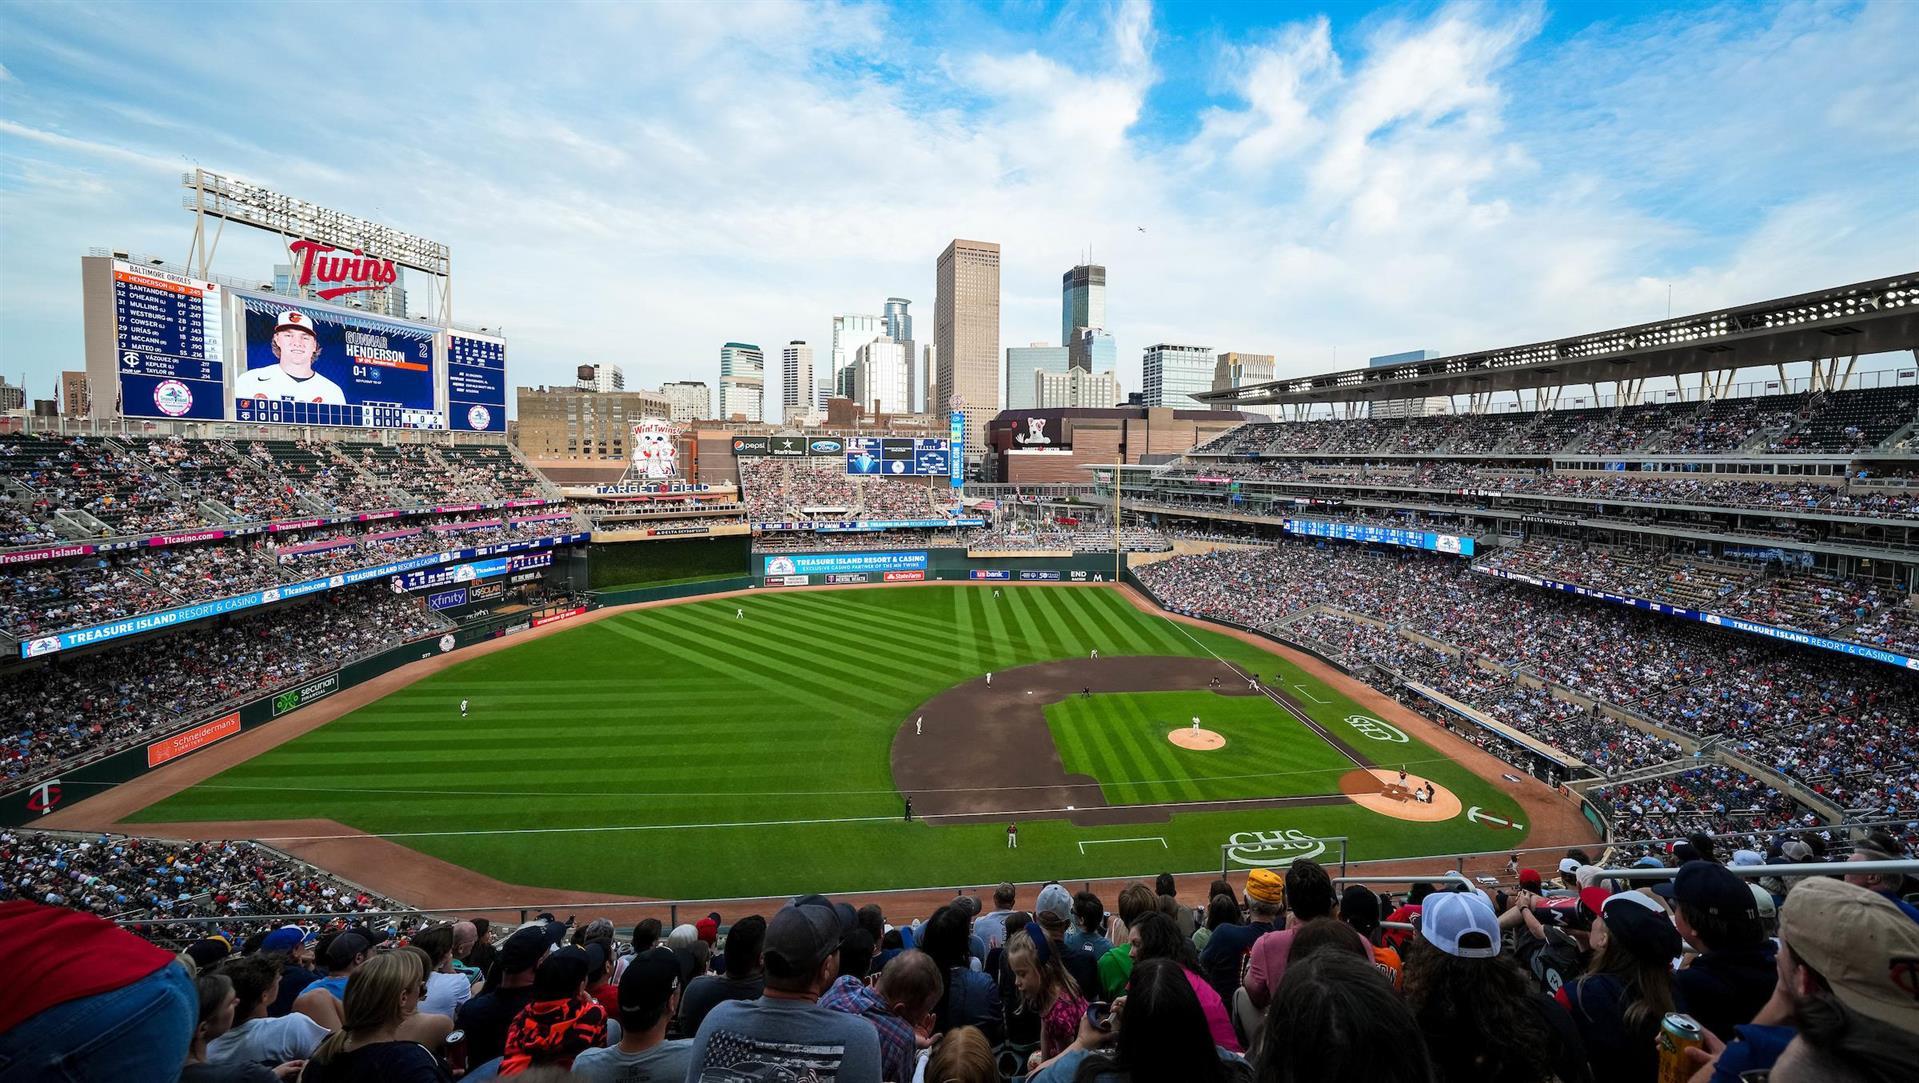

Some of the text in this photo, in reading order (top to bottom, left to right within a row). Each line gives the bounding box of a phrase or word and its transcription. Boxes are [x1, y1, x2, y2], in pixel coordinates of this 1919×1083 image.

[289, 240, 396, 287] Twins
[130, 265, 191, 284] BALTIMORE ORIOLES
[128, 276, 167, 288] HENDERSON
[129, 284, 168, 297] SANTANDER
[129, 293, 159, 303] O'HEARN
[130, 301, 158, 311] MULLINS
[130, 310, 166, 320] WESTBURG
[130, 318, 159, 328] COWSER
[131, 326, 151, 335] URÍAS
[131, 335, 159, 345] MCCANN
[345, 331, 428, 358] GUNNAR 2
[131, 343, 154, 352] MATEO
[346, 344, 405, 362] HENDERSON
[145, 354, 172, 363] VÁZQUEZ
[353, 366, 366, 376] 0-1
[260, 401, 265, 409] 0
[273, 402, 278, 410] 0
[634, 424, 680, 434] Win! Twins!
[600, 484, 710, 494] TARGET FIELD
[51, 546, 84, 558] Island
[346, 570, 377, 583] TREASURE
[378, 566, 397, 576] ISLAND
[398, 561, 415, 571] RESORT
[420, 557, 438, 566] CASINO
[432, 592, 464, 608] xfinity
[68, 596, 257, 644] TREASURE ISLAND RESORT & CASINO
[1733, 621, 1774, 637] TREASURE
[1776, 629, 1809, 643] ISLAND
[1811, 638, 1846, 651] RESORT
[1859, 648, 1895, 663] CASINO
[301, 677, 335, 697] securian
[301, 688, 326, 702] FINANCIAL
[173, 718, 235, 748] Schneiderman's
[1344, 717, 1392, 740] CHS
[174, 738, 204, 752] FURNITURE
[1229, 829, 1315, 853] CHS
